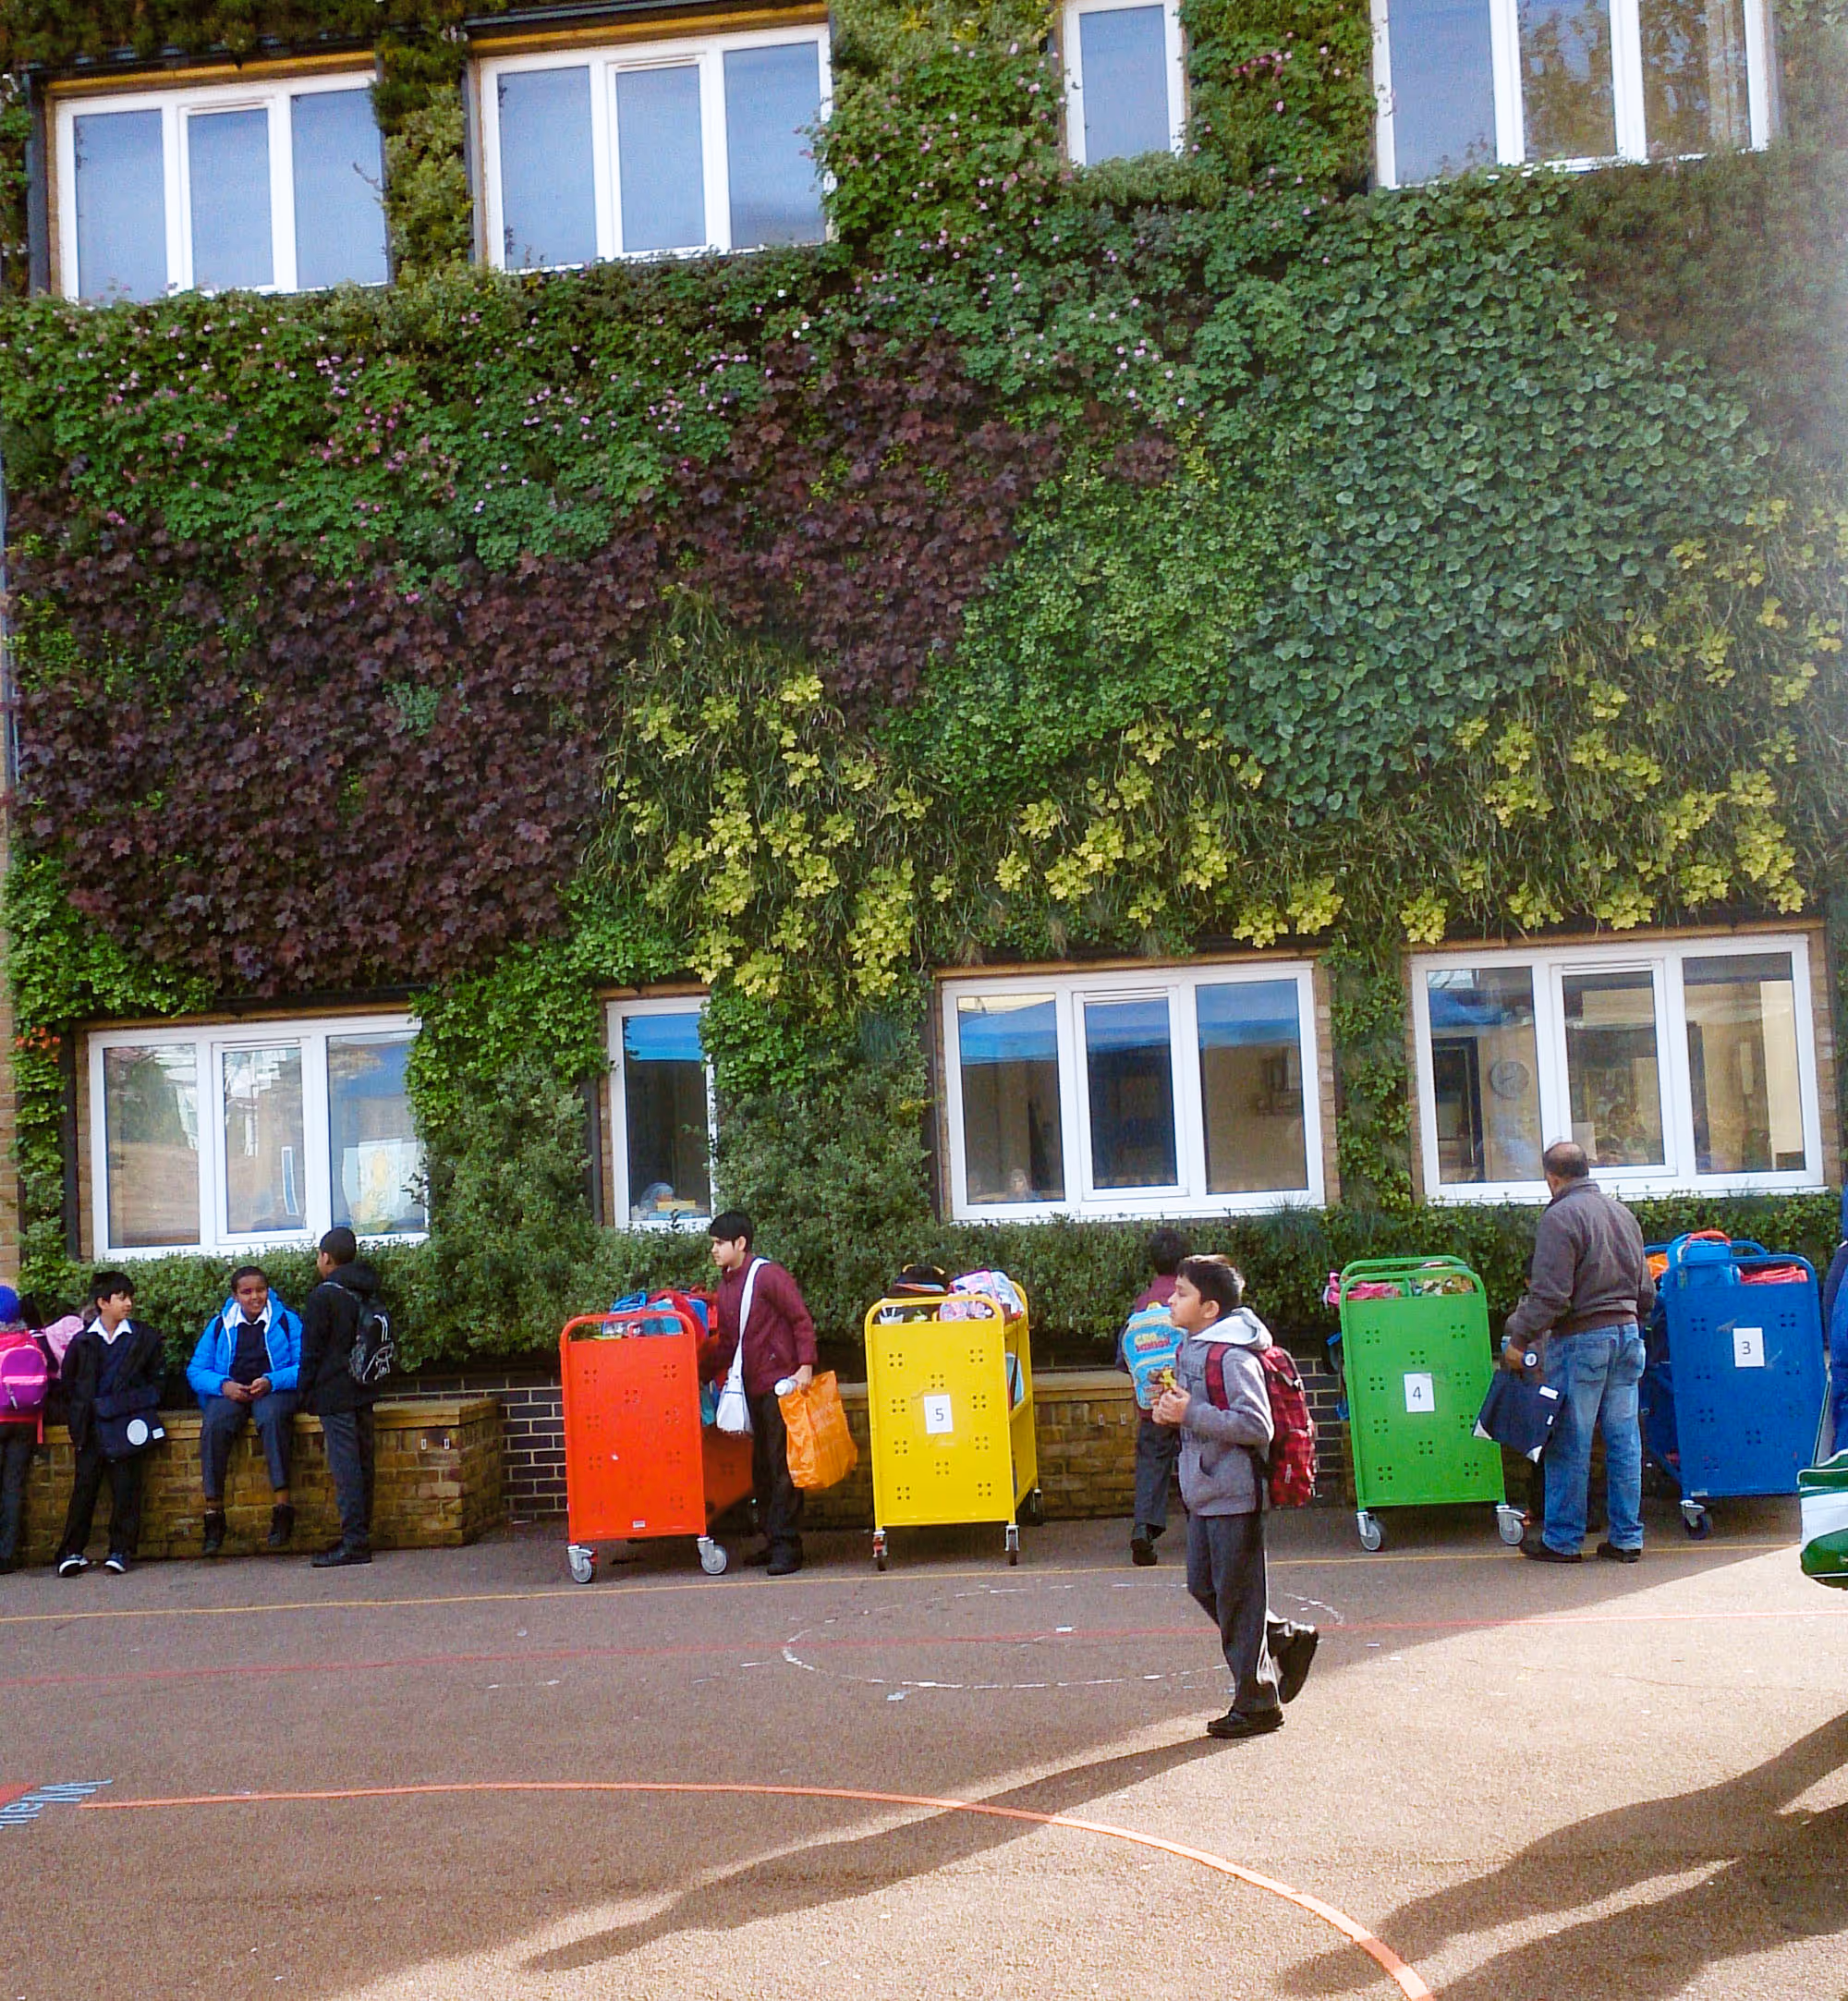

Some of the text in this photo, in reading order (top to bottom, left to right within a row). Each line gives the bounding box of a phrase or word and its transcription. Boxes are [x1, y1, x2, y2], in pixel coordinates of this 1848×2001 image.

[1742, 1341, 1751, 1355] 3
[1413, 1386, 1422, 1401] 4
[935, 1408, 944, 1421] 5
[0, 1778, 113, 1829] Wall
